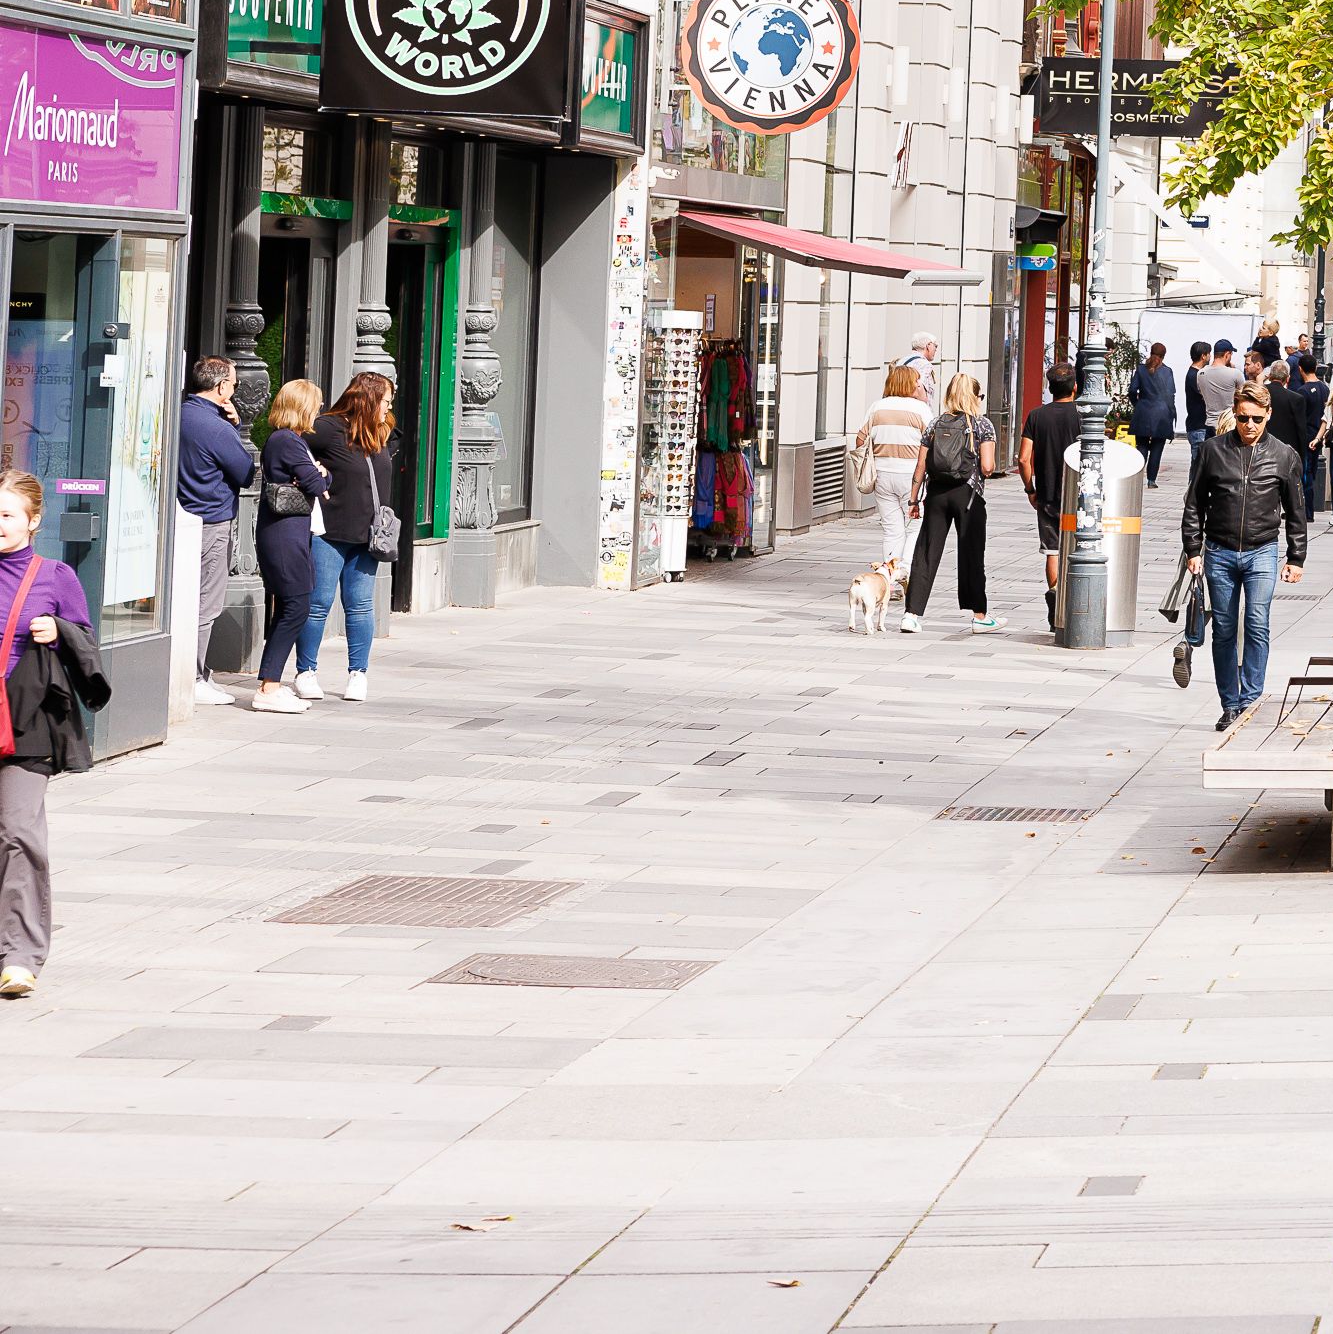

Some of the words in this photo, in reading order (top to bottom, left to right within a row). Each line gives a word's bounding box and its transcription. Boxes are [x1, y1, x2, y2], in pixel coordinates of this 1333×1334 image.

[384, 33, 506, 80] WORLD
[708, 56, 835, 113] VIENNA
[4, 70, 119, 156] Marionnaud
[47, 160, 78, 184] PARIS
[61, 480, 100, 491] DRÜCKEN
